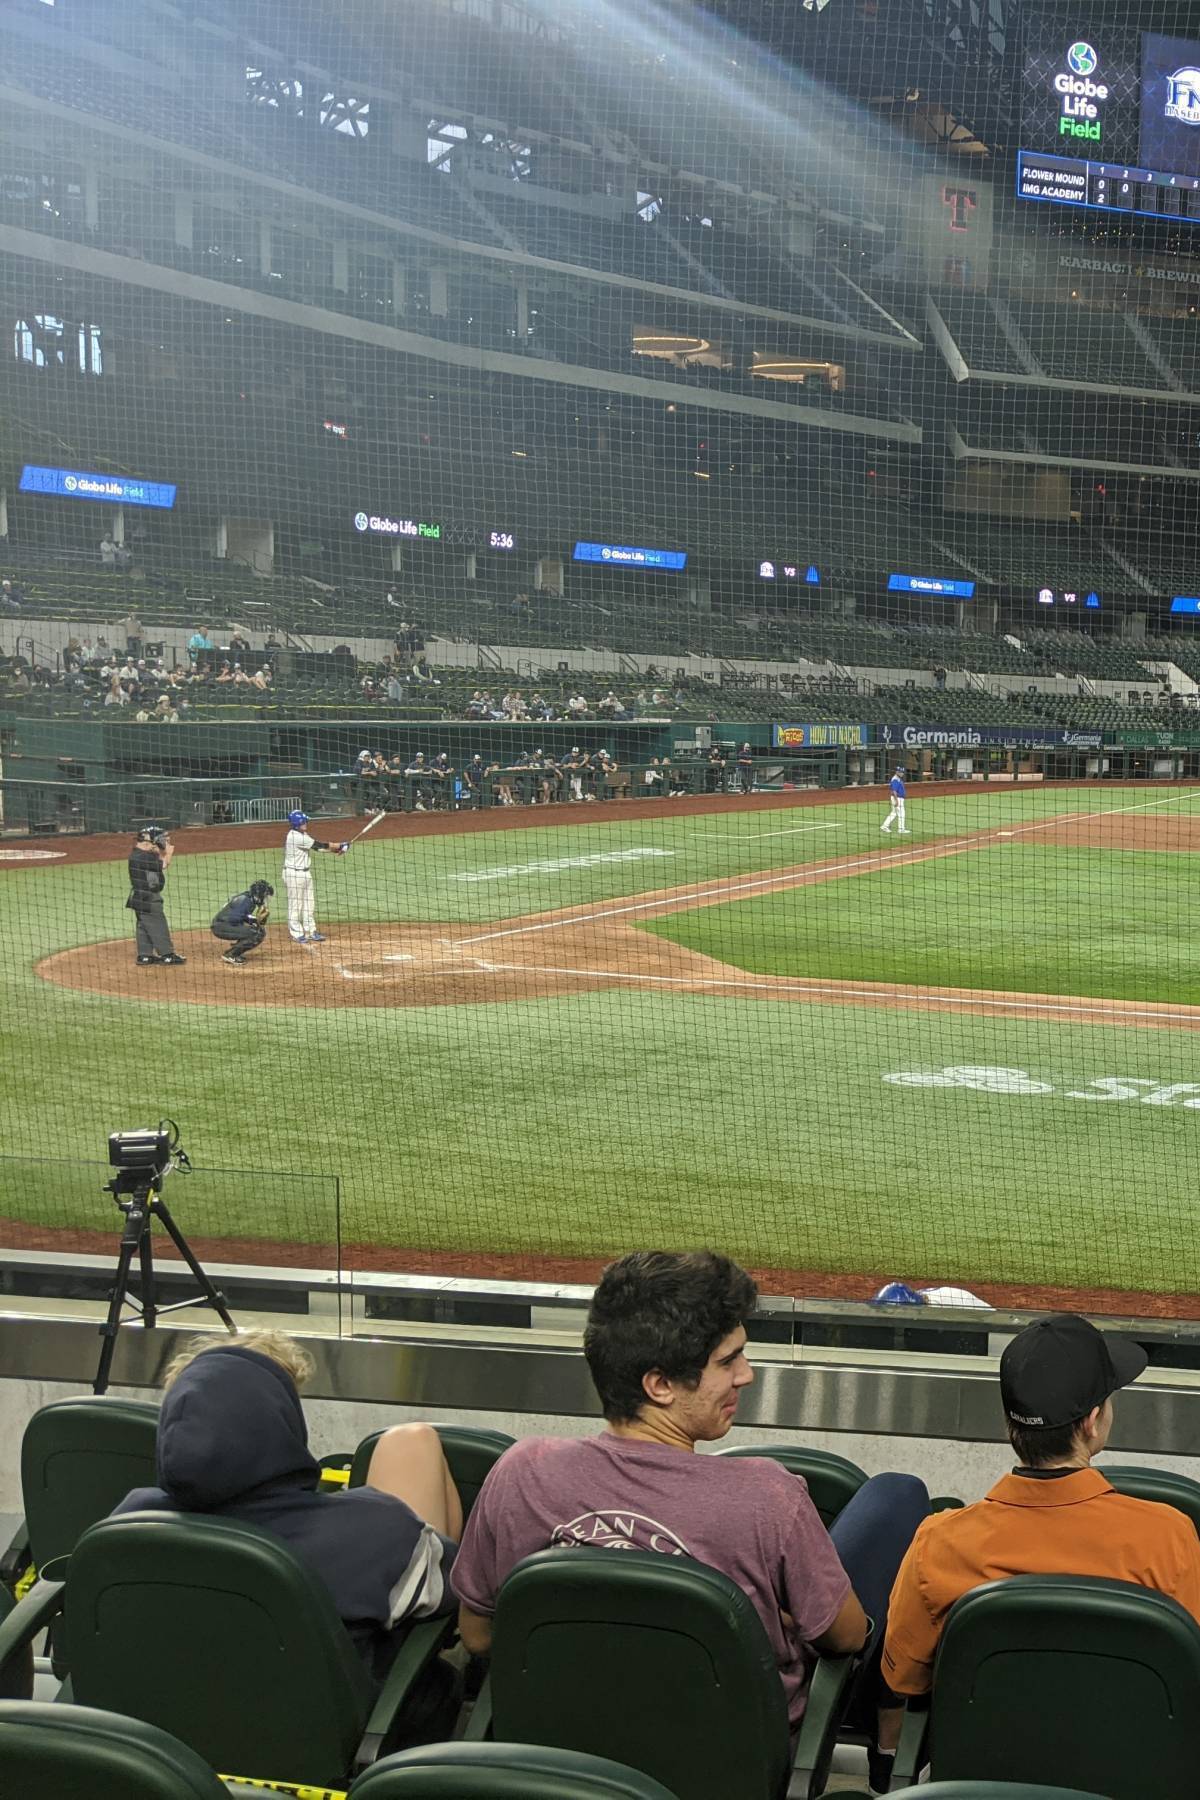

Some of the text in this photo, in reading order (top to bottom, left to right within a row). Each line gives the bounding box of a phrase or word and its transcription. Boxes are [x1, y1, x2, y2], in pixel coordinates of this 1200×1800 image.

[1055, 74, 1109, 100] Globe
[1064, 95, 1098, 118] Life
[1060, 117, 1101, 140] Field
[1023, 167, 1054, 181] FLOWER
[1055, 172, 1085, 187] MOUND
[1098, 180, 1105, 189] 0
[1122, 183, 1129, 193] 0
[1100, 166, 1105, 174] 1
[1123, 170, 1129, 178] 2
[1147, 173, 1153, 182] 3
[1169, 177, 1176, 185] 4
[1193, 180, 1199, 188] 5
[1022, 182, 1040, 195] IMG
[1042, 185, 1085, 201] ACADEMY
[1097, 194, 1104, 203] 2
[78, 479, 144, 498] Globe Life Field
[369, 516, 440, 539] Globe Life Field
[490, 532, 514, 548] 5:36
[611, 550, 632, 560] Globe
[632, 552, 645, 561] Life
[784, 566, 796, 577] VS
[1064, 592, 1076, 602] VS
[810, 725, 827, 745] HOW
[828, 726, 838, 745] TO
[903, 726, 982, 744] Germania
[1072, 733, 1101, 742] Germania
[571, 1516, 635, 1538] EAN
